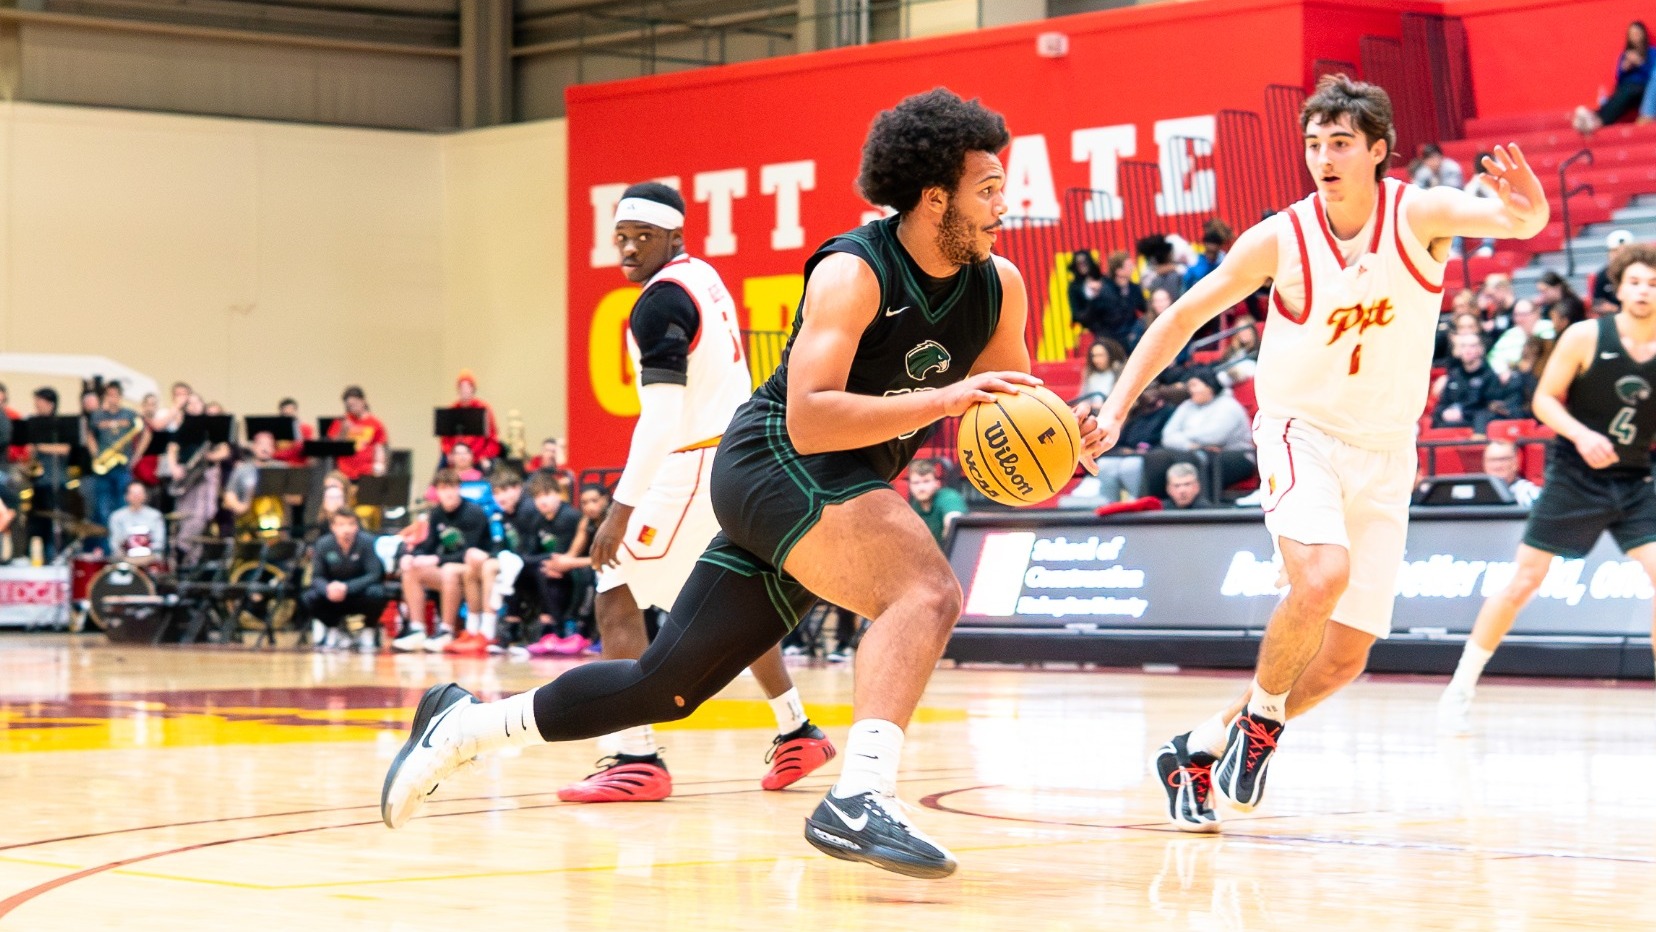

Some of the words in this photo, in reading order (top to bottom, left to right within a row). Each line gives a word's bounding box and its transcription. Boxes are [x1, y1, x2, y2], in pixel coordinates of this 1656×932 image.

[590, 159, 816, 268] PTT
[866, 115, 1215, 230] ATE
[984, 420, 1033, 496] Wilson
[1608, 406, 1637, 445] 4
